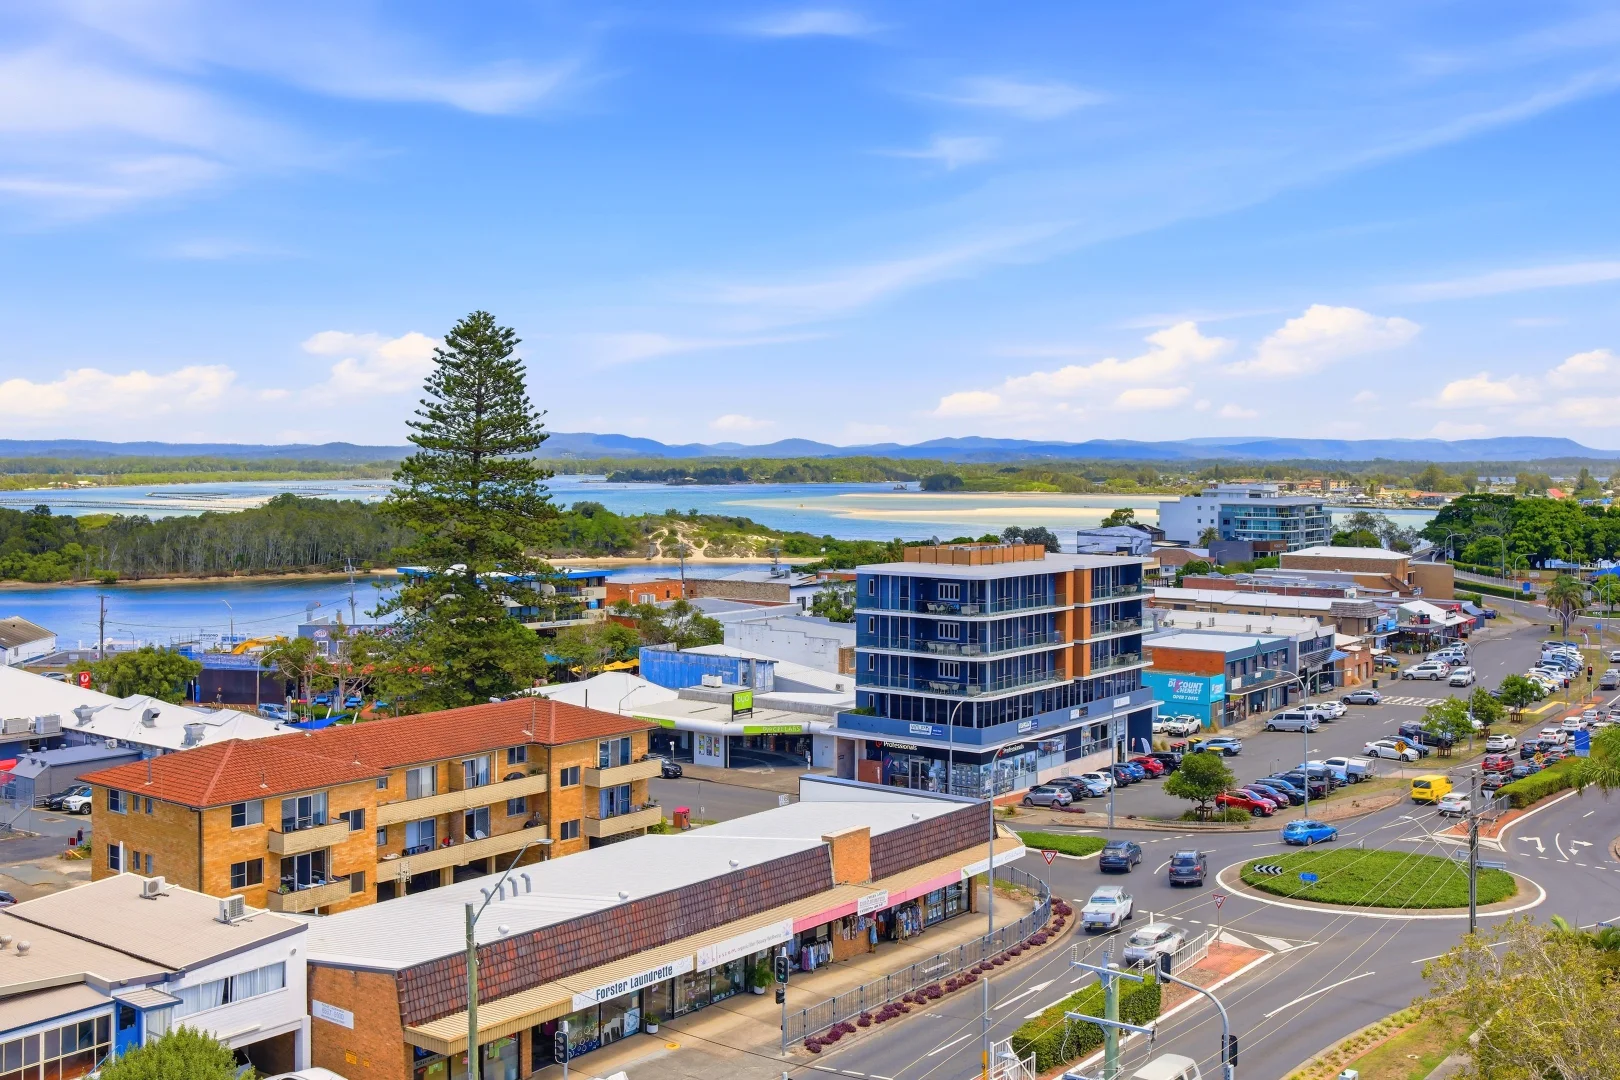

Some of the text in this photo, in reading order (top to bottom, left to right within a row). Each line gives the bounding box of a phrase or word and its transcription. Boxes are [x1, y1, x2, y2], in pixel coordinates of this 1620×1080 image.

[883, 740, 918, 751] Professionals
[596, 965, 673, 1001] Forster Laundrette
